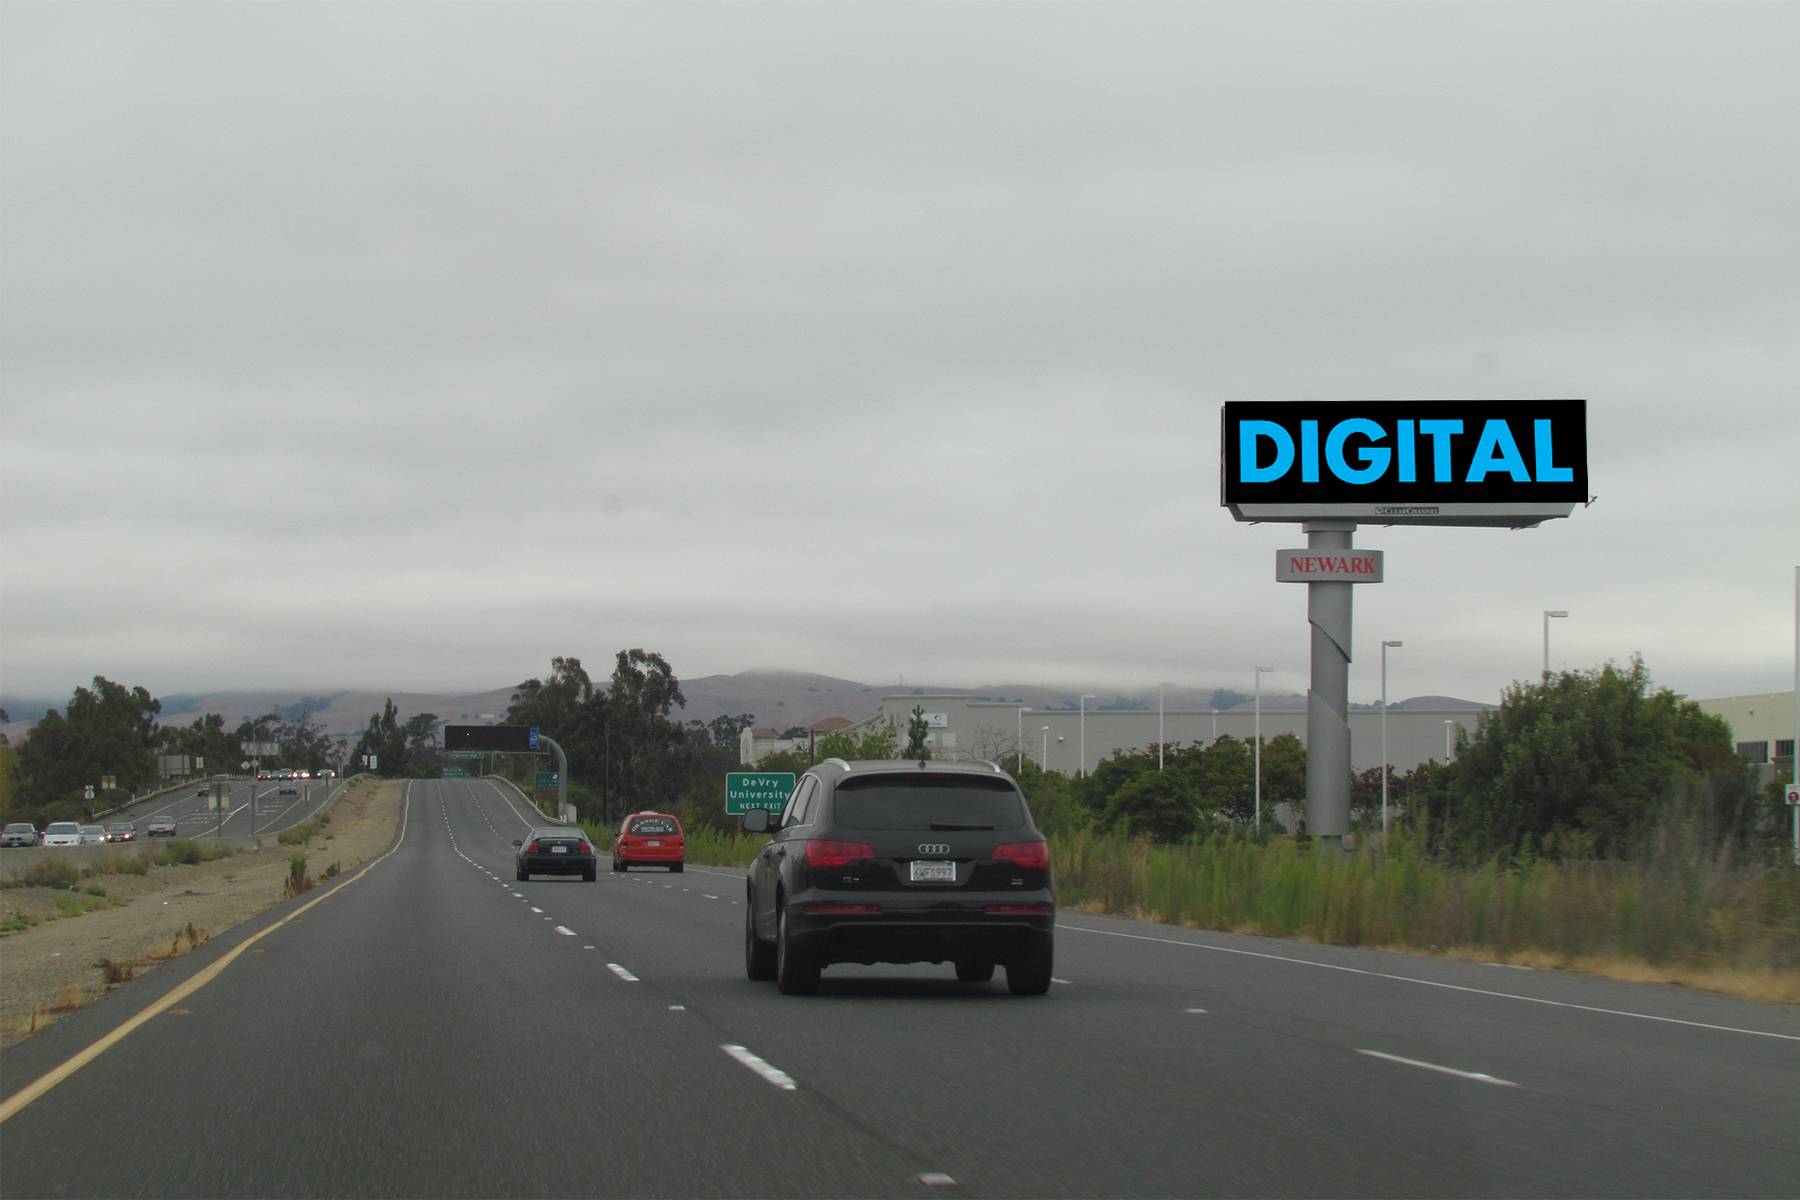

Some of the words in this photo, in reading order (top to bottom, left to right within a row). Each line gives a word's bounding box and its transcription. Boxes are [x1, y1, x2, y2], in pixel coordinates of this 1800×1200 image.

[1239, 418, 1574, 485] DIGITAL
[1290, 557, 1376, 574] NEWARK
[743, 779, 778, 788] DeVry
[730, 790, 790, 801] University
